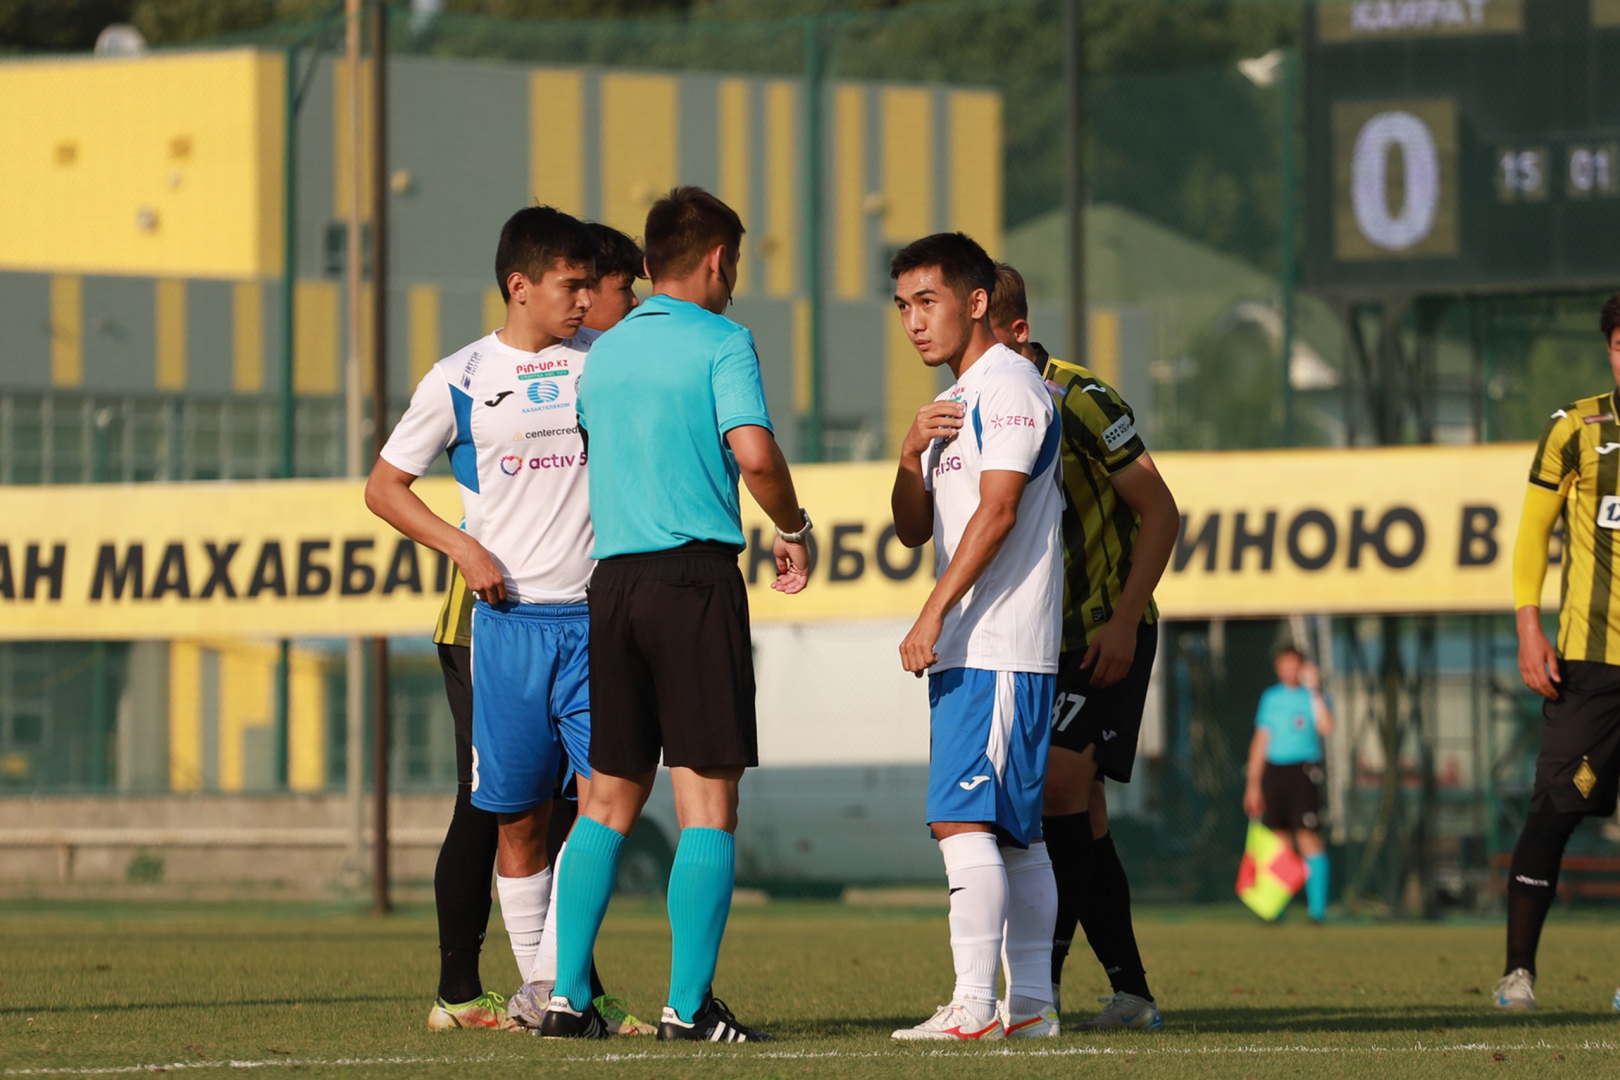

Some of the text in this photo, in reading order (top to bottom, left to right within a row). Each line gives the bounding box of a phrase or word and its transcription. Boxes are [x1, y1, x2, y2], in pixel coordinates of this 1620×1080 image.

[1353, 111, 1439, 250] 0
[1006, 415, 1036, 429] ZETA
[529, 453, 576, 470] activ
[1457, 505, 1500, 567] В
[1051, 691, 1087, 732] 87
